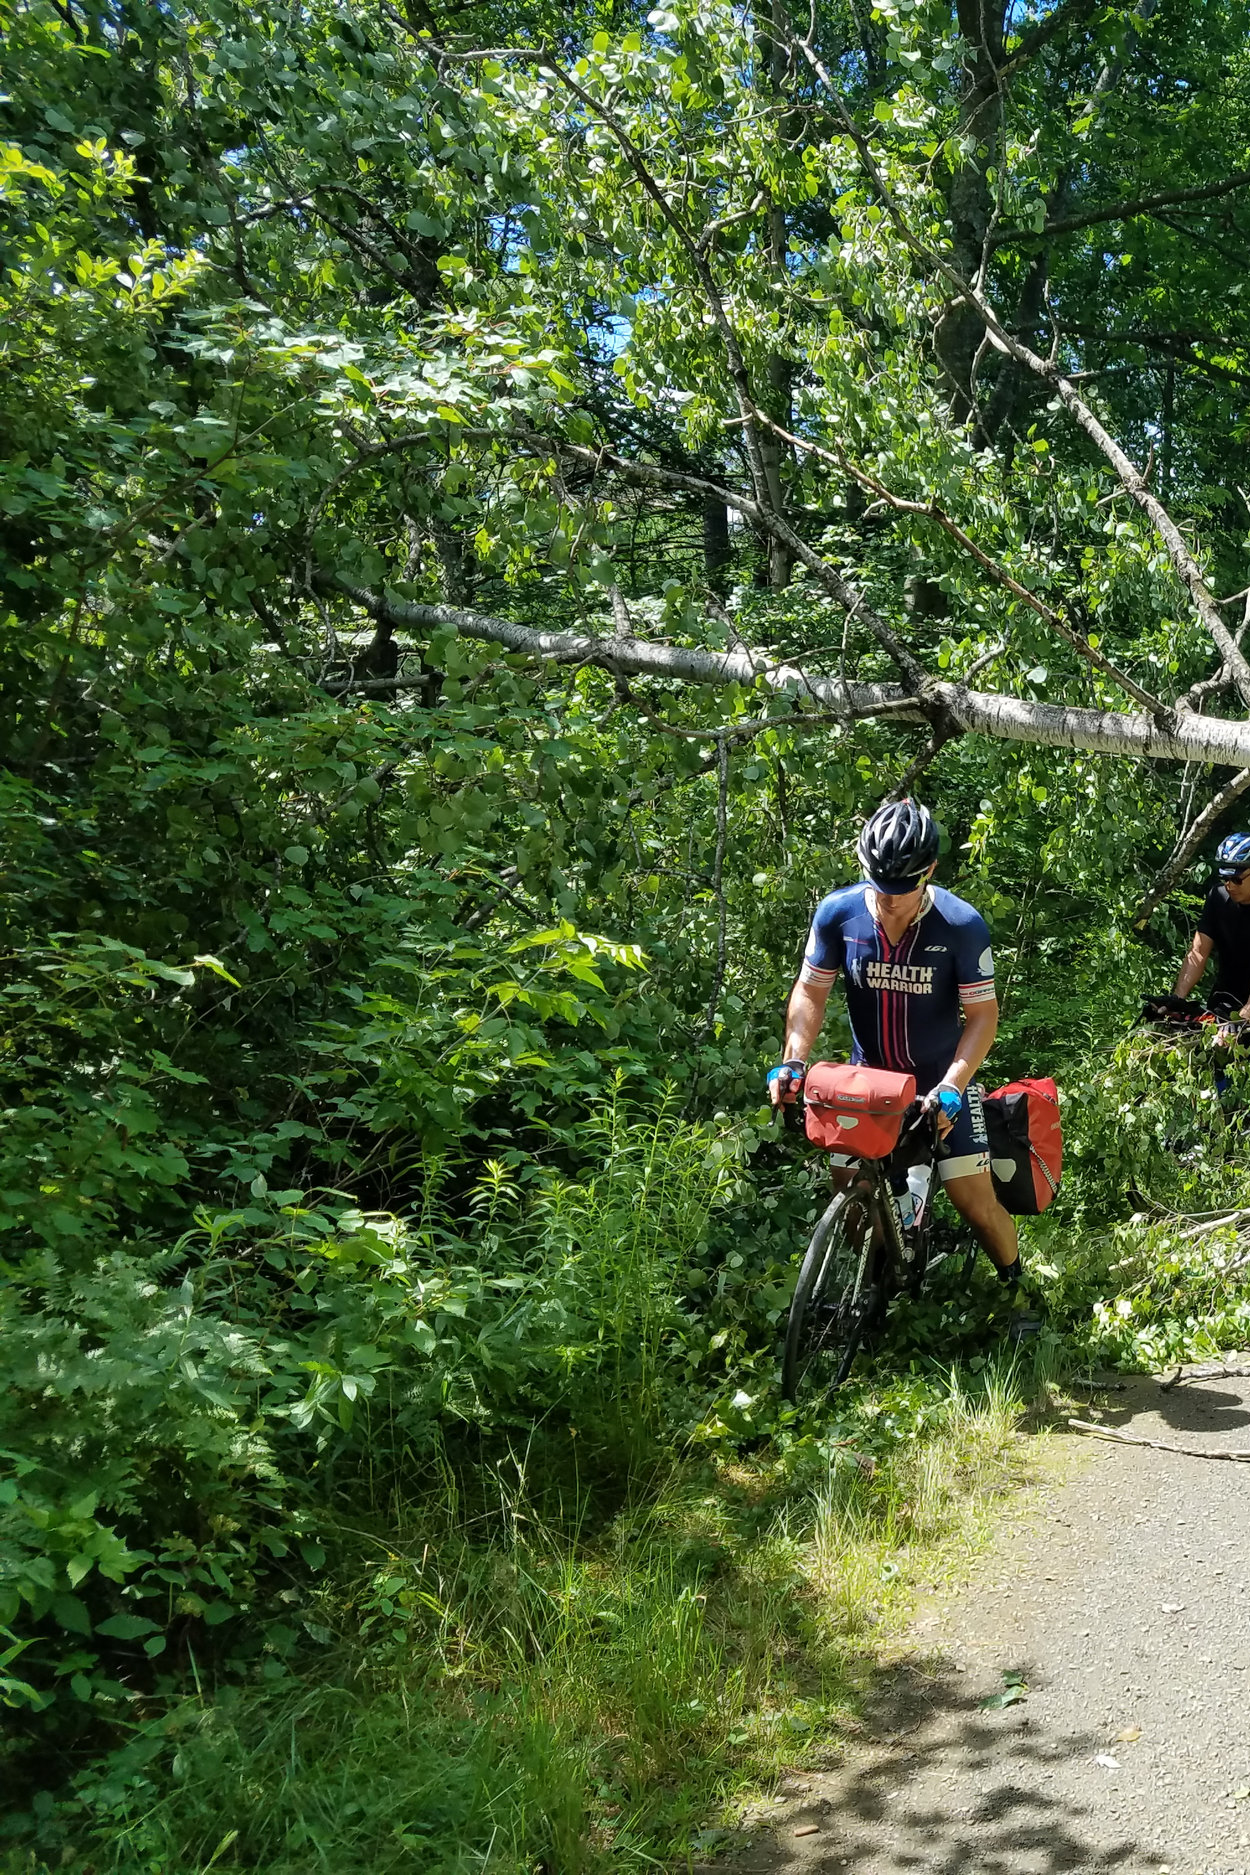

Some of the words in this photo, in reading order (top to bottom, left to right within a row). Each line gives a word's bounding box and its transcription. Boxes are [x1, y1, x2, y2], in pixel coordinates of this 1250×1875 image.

[866, 961, 933, 982] HEALTH
[866, 977, 933, 994] WARRIOR
[966, 1085, 985, 1133] HEALTH
